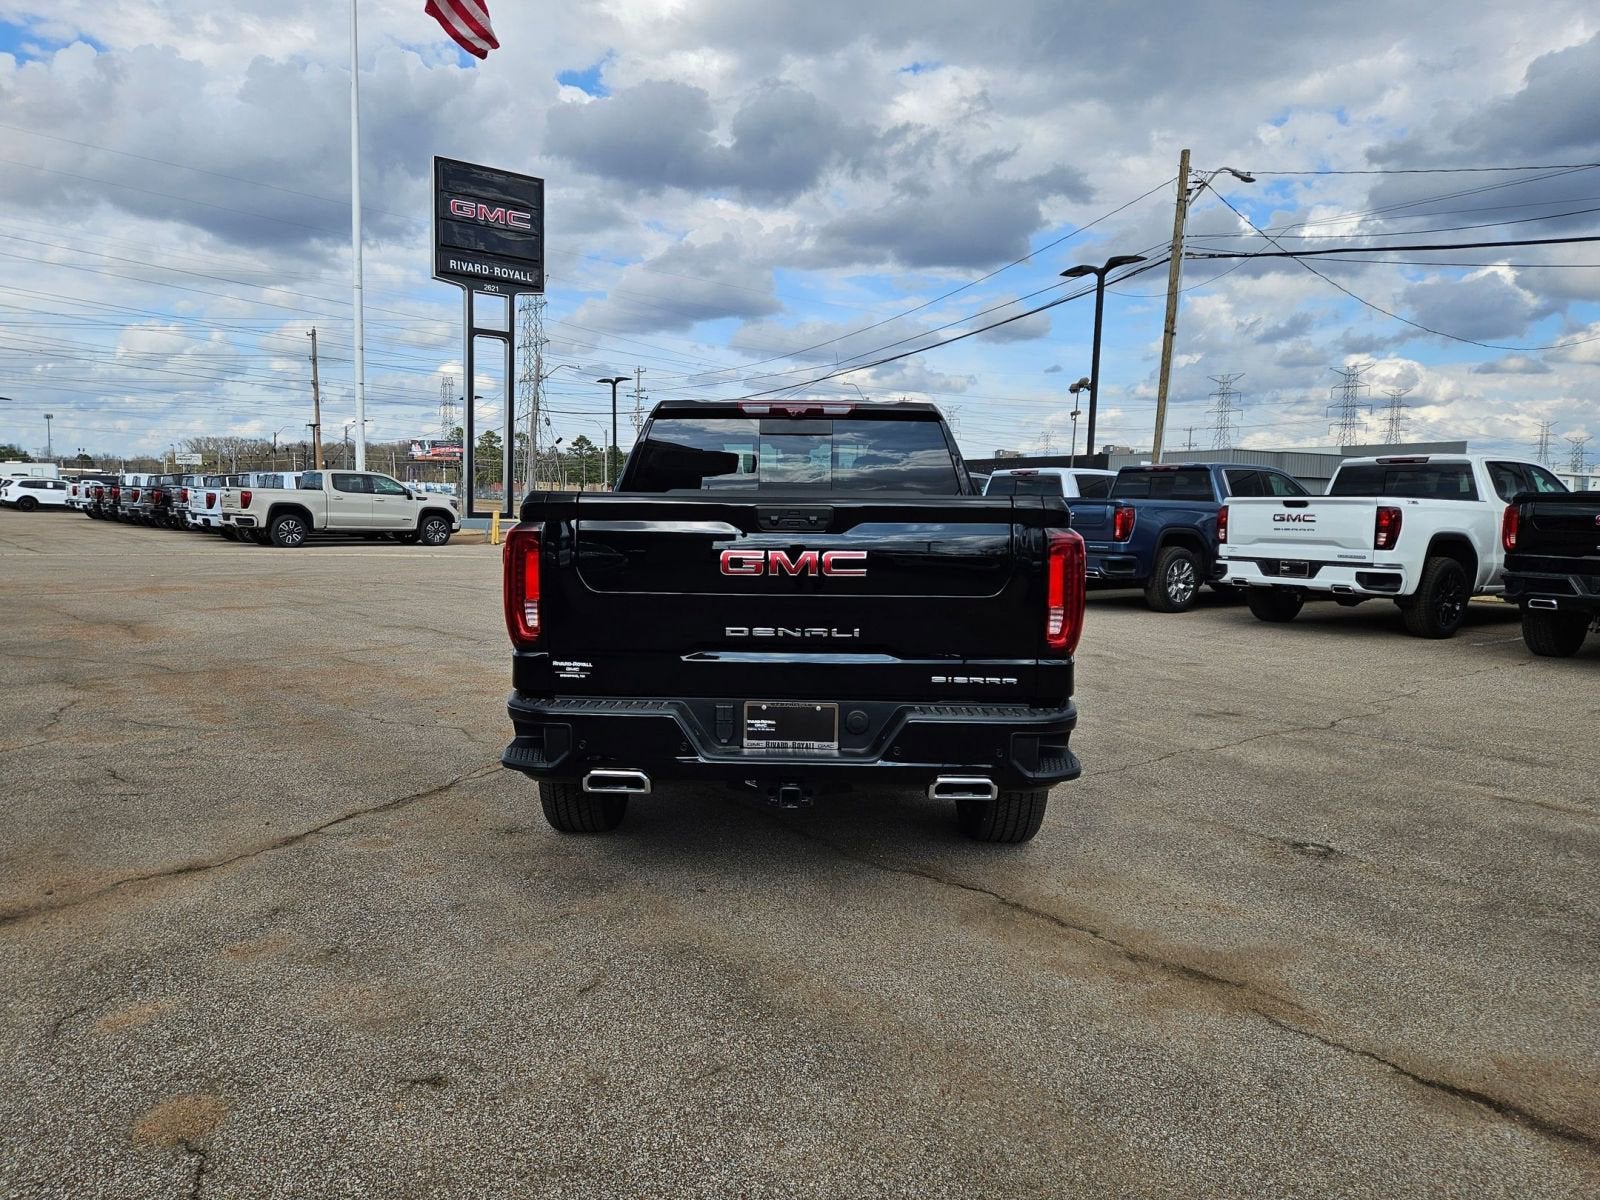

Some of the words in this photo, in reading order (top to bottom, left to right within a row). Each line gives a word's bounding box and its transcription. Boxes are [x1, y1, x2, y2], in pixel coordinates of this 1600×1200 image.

[450, 199, 531, 229] GMC
[449, 260, 533, 282] RIVARD-ROYALL
[483, 284, 499, 292] 2621
[1273, 514, 1316, 522] GMC
[720, 550, 867, 576] GMC
[725, 627, 860, 637] DENALI
[931, 676, 1018, 685] SIERRA
